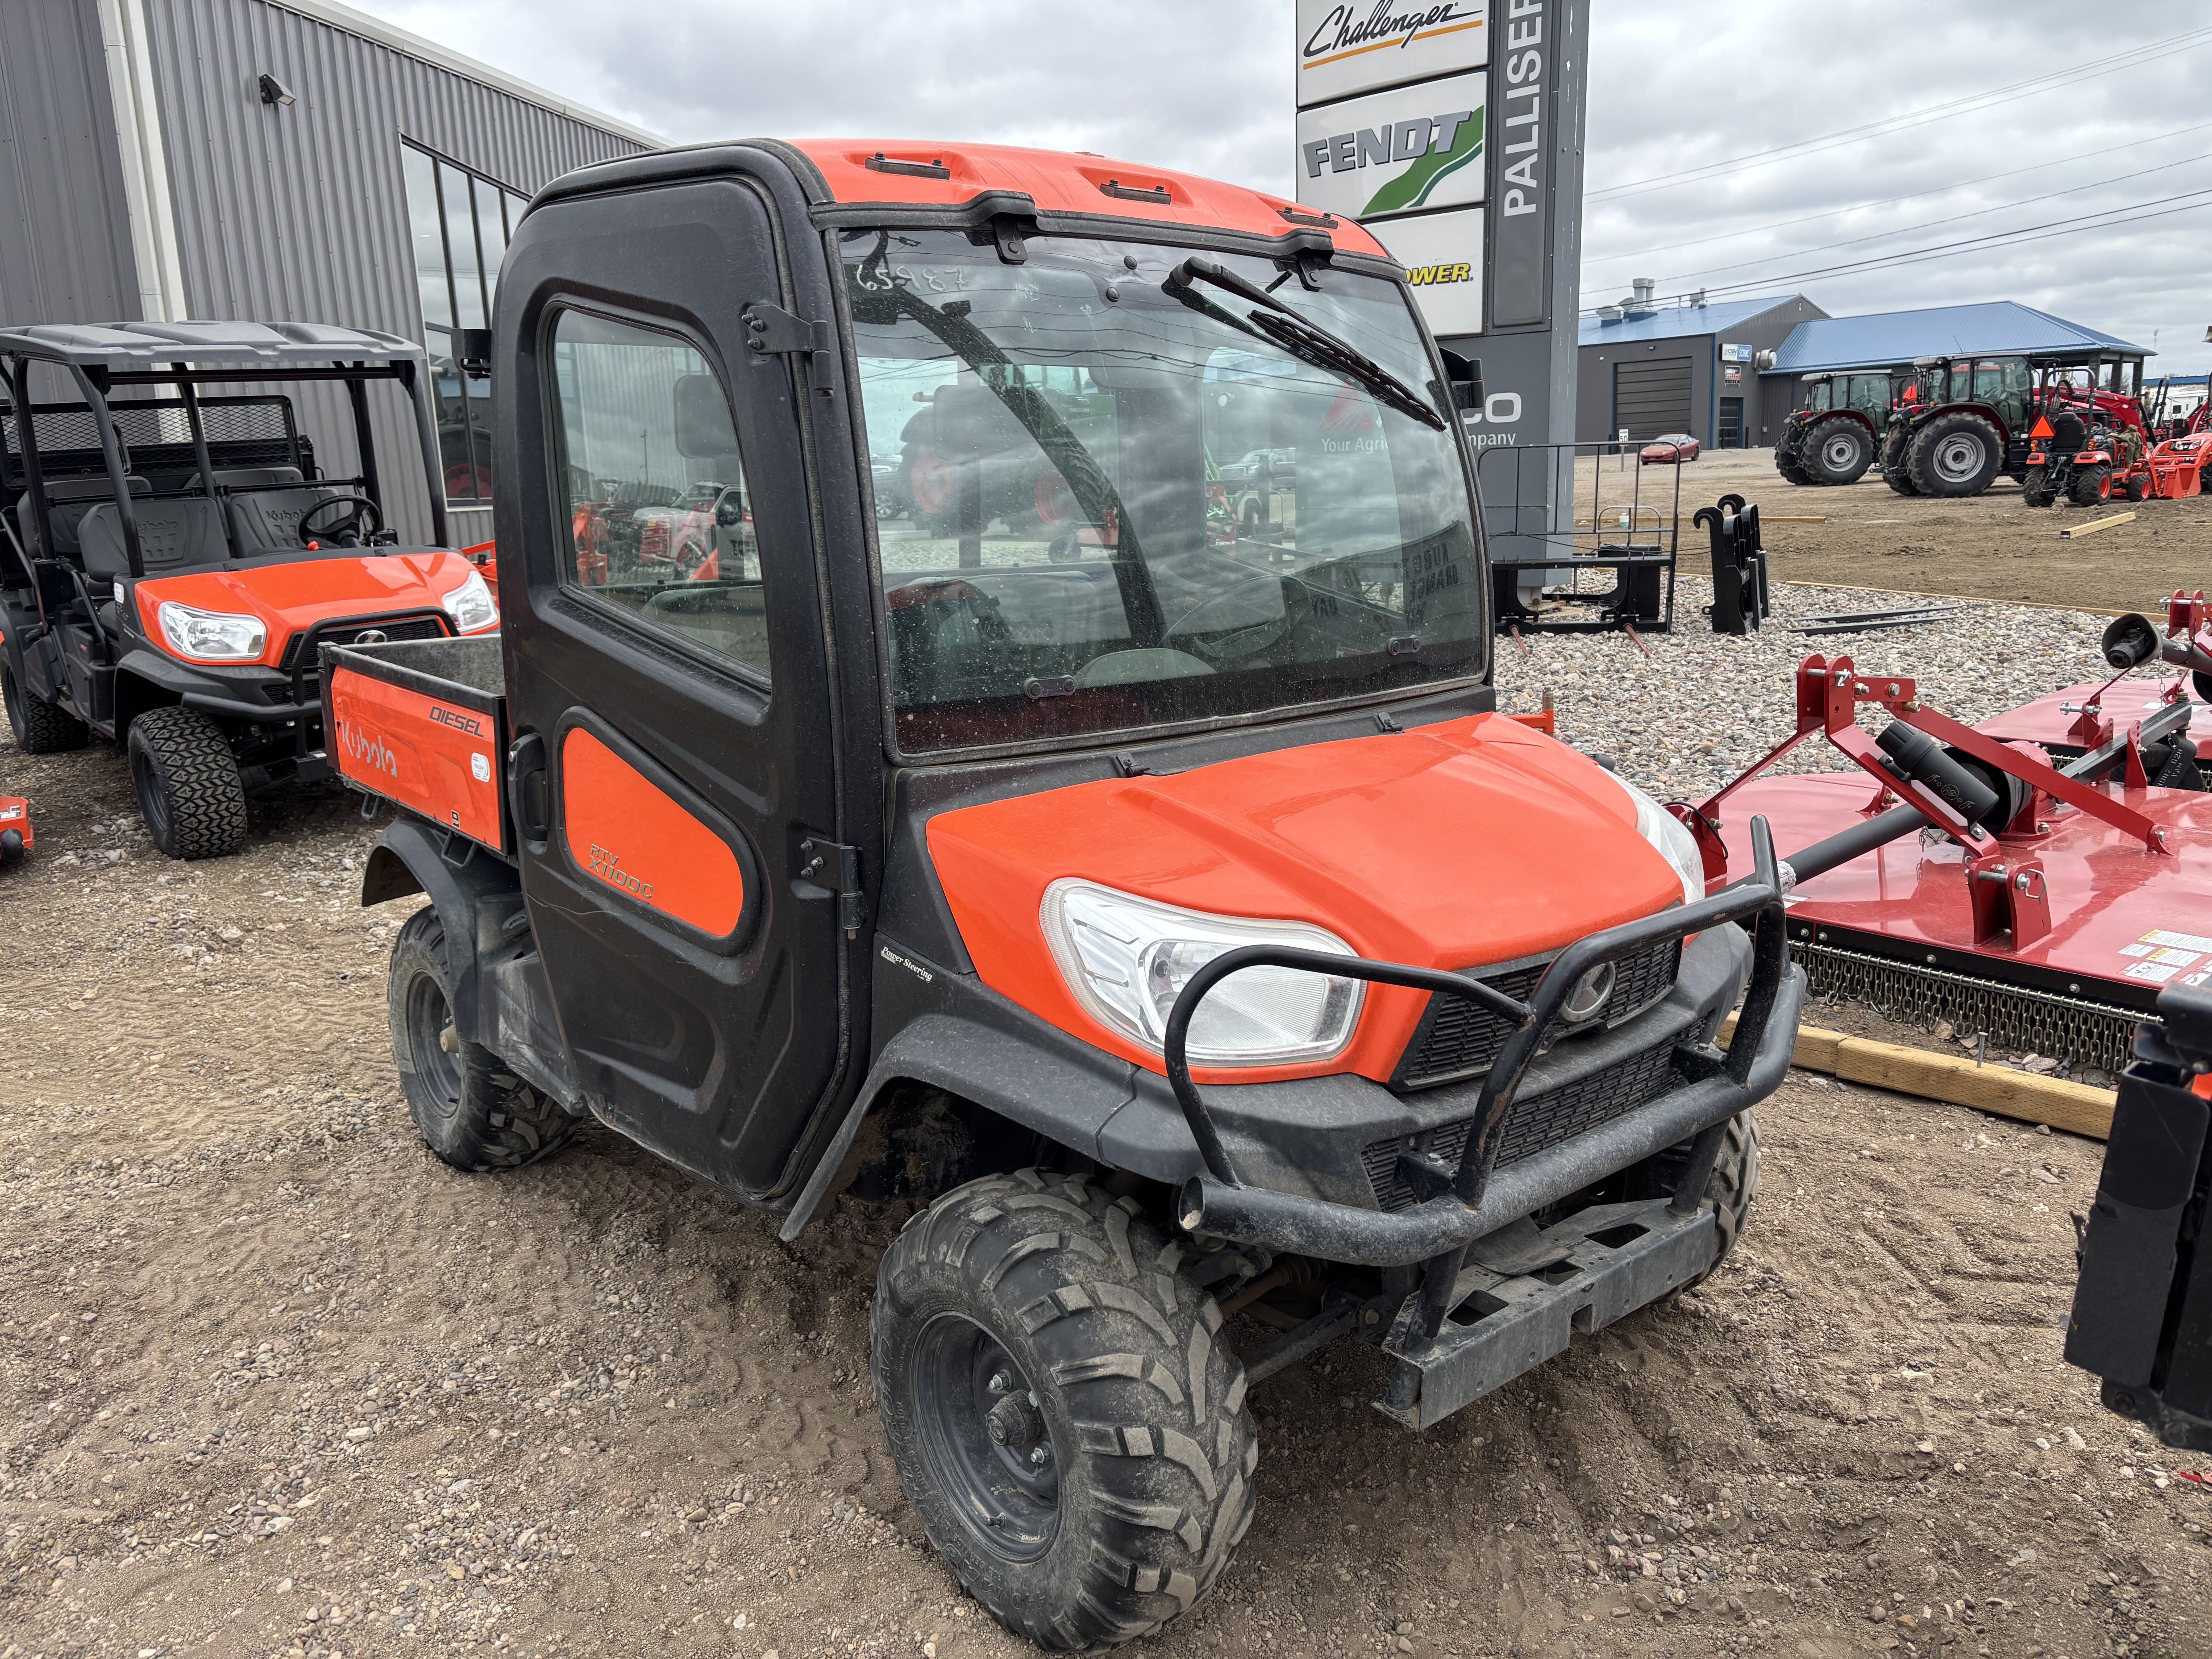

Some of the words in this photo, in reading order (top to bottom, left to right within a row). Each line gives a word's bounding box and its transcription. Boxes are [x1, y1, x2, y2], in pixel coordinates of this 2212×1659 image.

[1304, 0, 1483, 57] Challenger
[1302, 110, 1472, 178] FENDT
[1321, 438, 1350, 452] Your
[429, 706, 484, 738] DIESEL
[340, 718, 397, 777] Kubota
[590, 843, 619, 865] RTV
[588, 855, 654, 898] X1100C
[882, 946, 904, 963] Power
[903, 958, 933, 981] Steering
